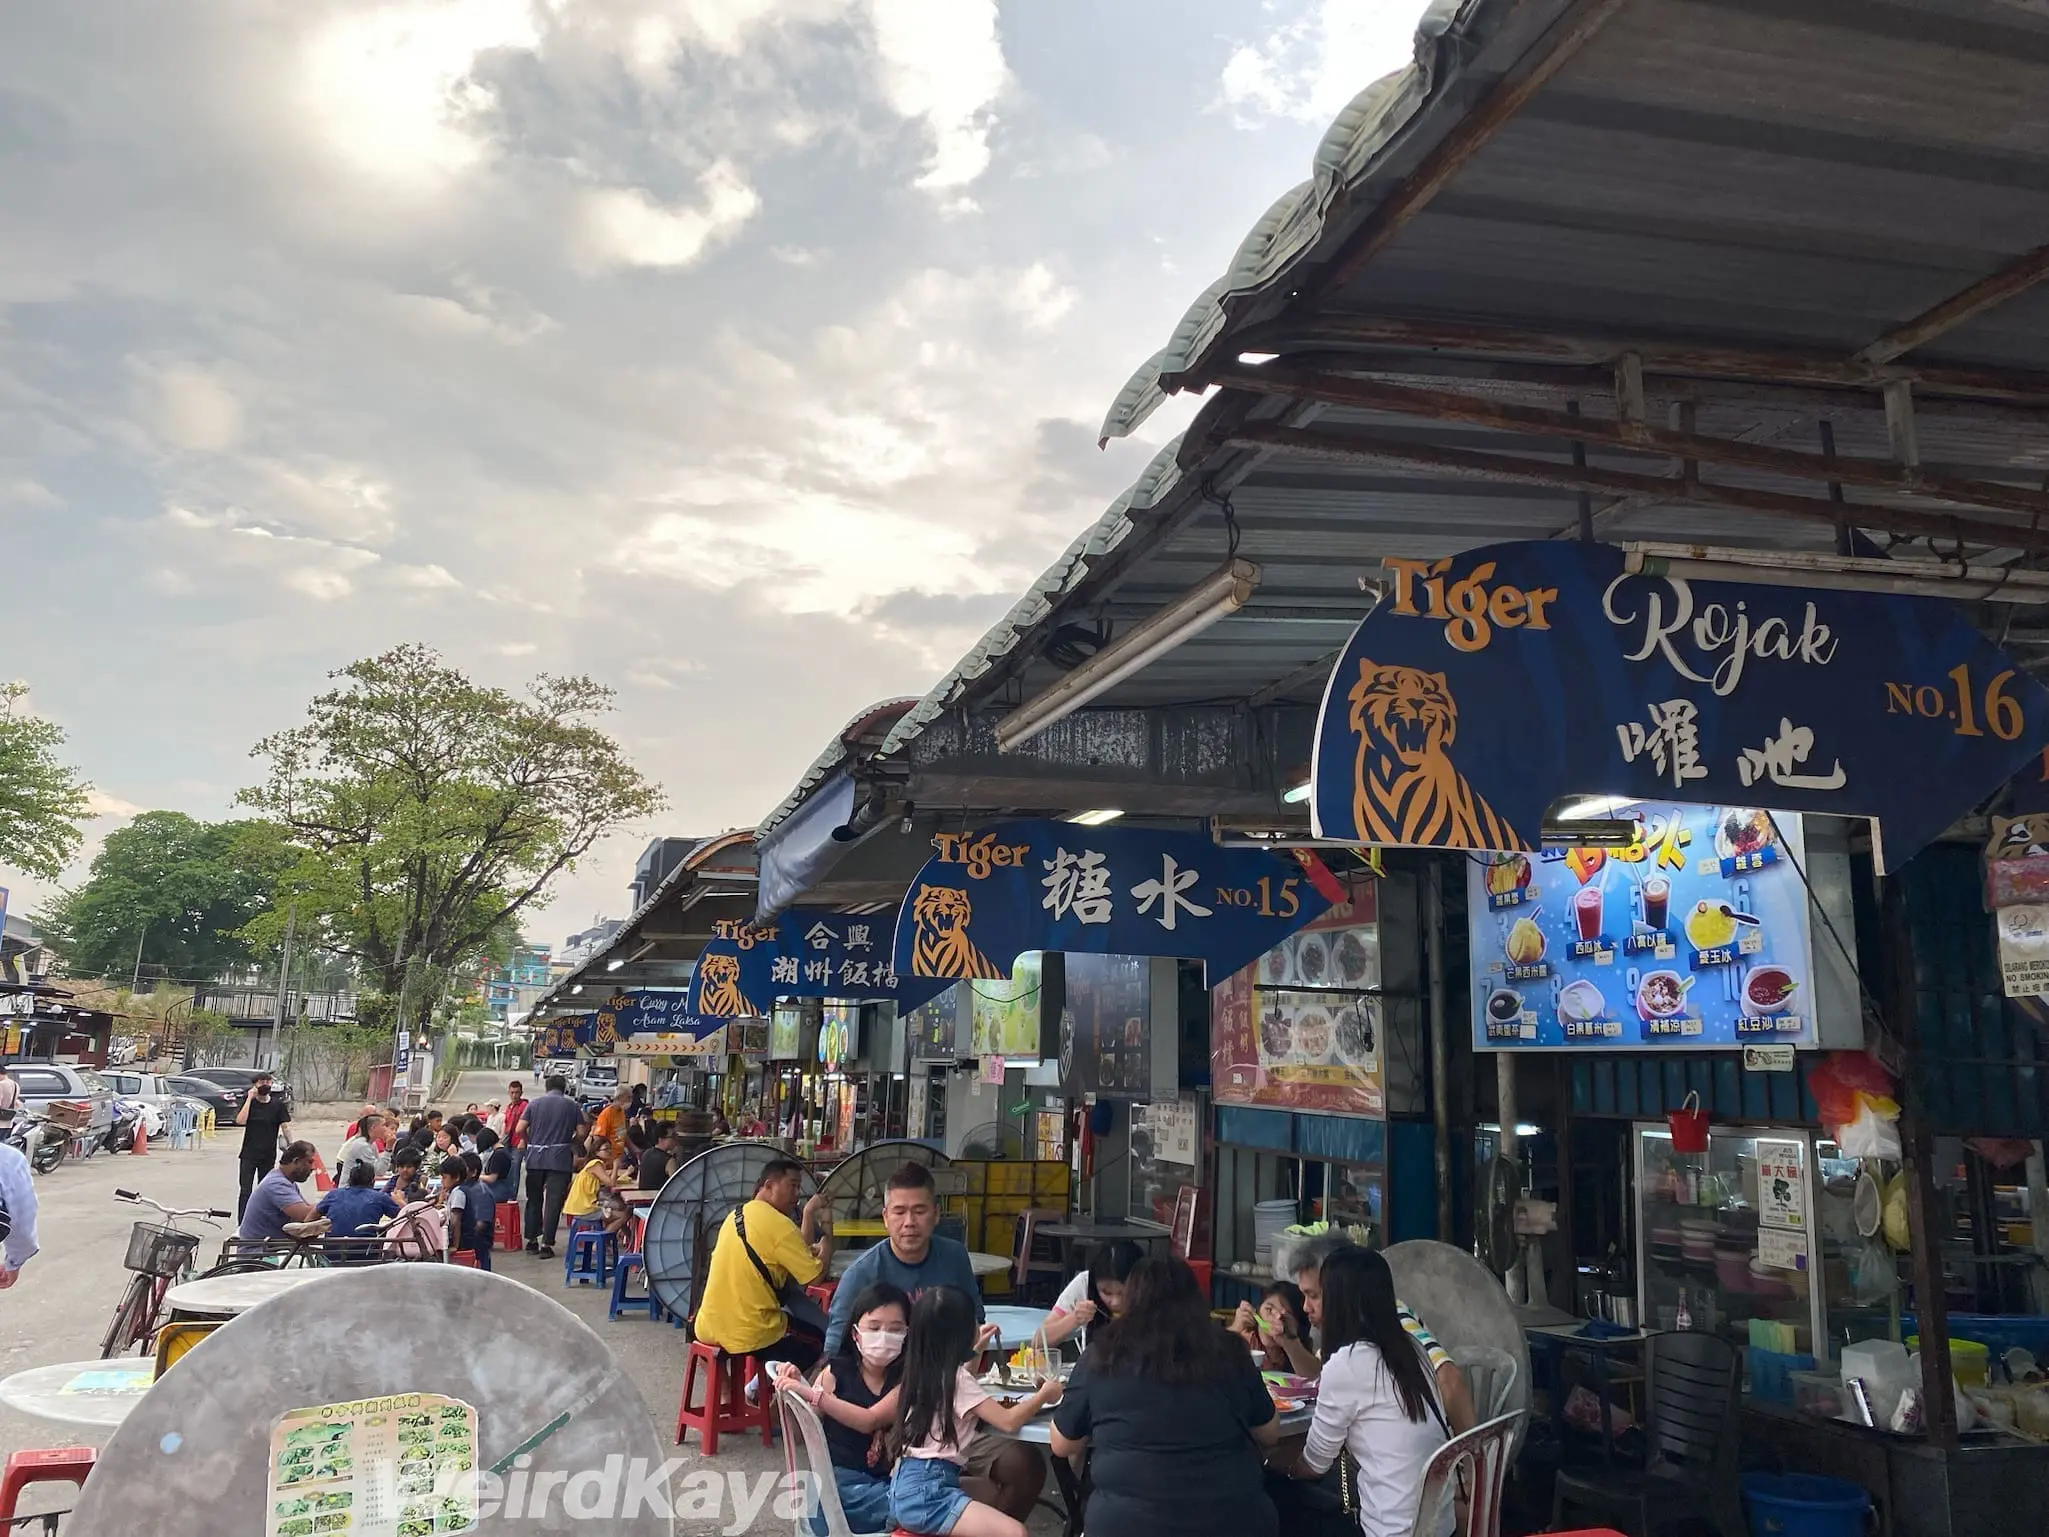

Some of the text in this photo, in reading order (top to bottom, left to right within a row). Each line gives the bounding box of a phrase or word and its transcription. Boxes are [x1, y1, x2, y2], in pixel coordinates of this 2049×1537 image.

[1381, 557, 1558, 652] Tiger
[1601, 571, 1840, 697] Rojak
[1884, 663, 2024, 741] NO.16
[935, 832, 1030, 880] Tiger
[1041, 847, 1213, 931] 糖水
[1216, 876, 1300, 919] NO.15
[715, 918, 779, 950] Tiger
[804, 920, 874, 953] 合興
[2006, 974, 2017, 982] NO
[606, 995, 636, 1011] Tiger
[633, 1013, 701, 1028] Asam Laksa
